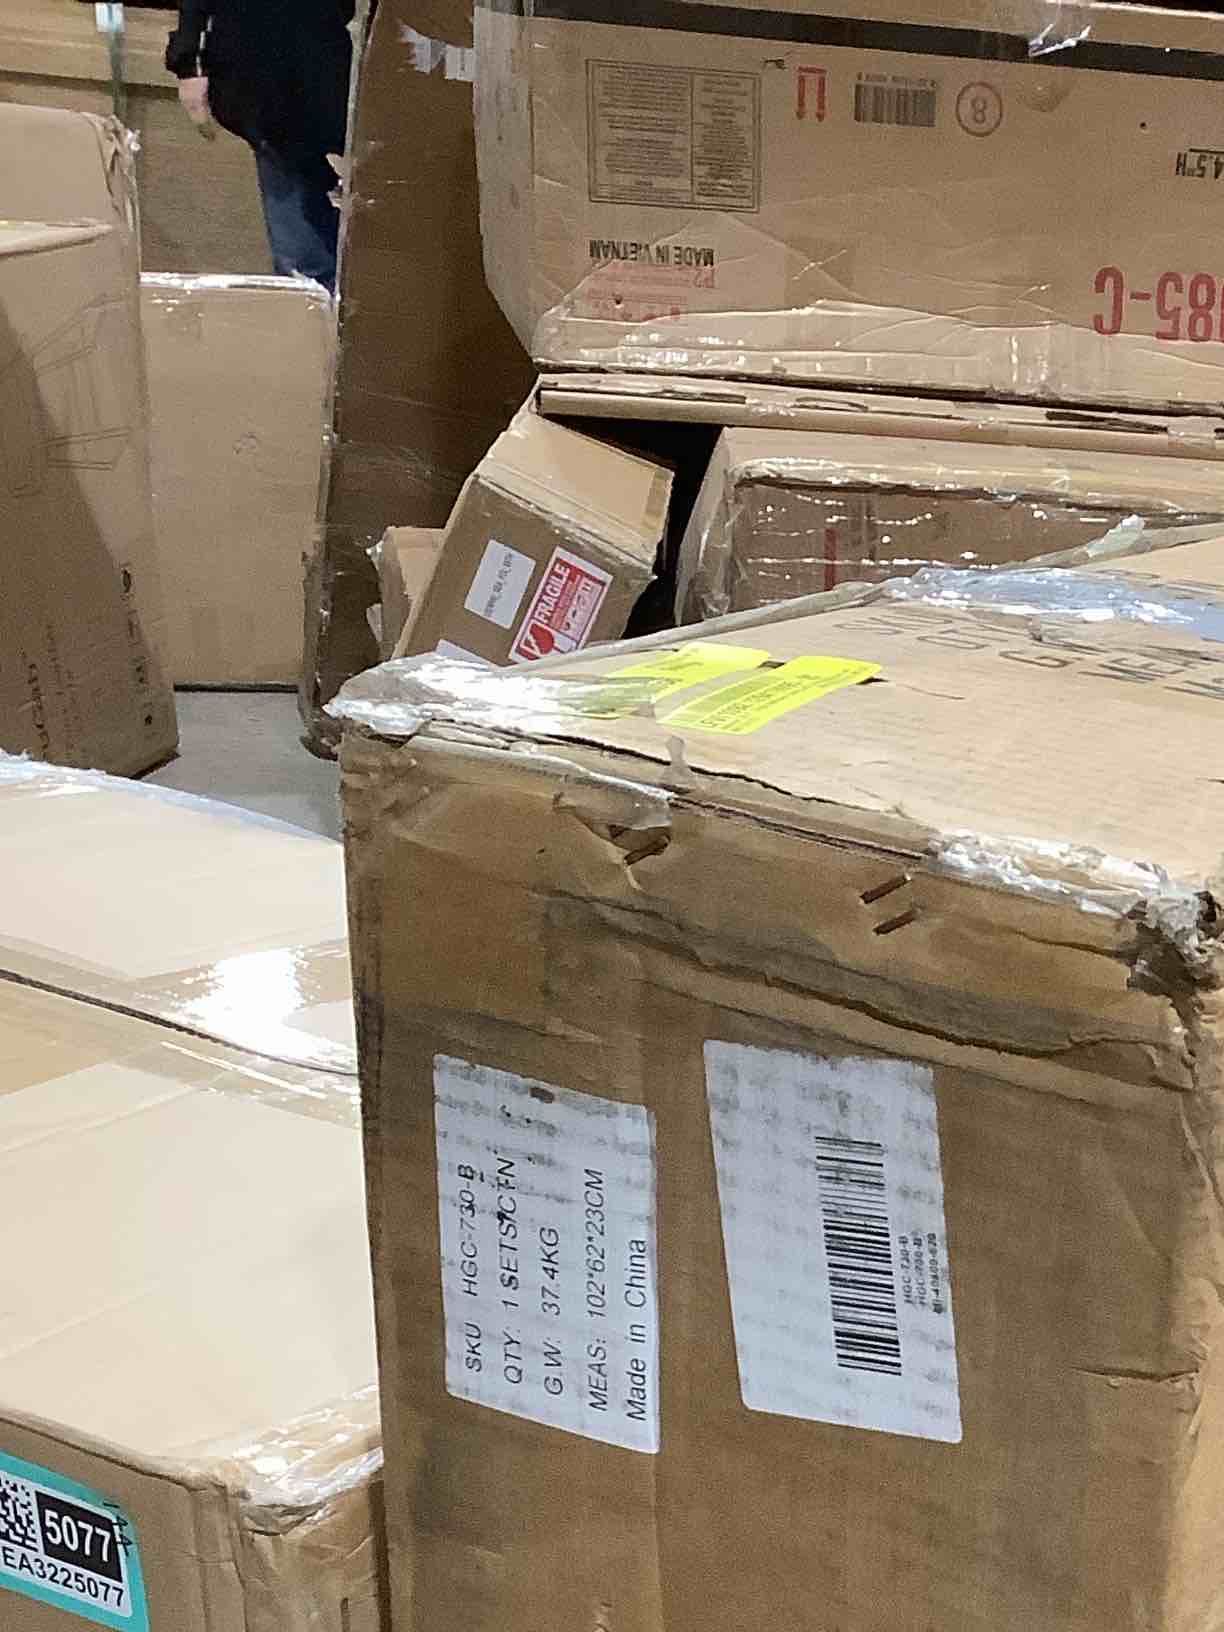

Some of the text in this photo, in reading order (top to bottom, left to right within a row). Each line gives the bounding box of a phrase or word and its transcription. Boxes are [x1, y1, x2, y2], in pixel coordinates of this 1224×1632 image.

[655, 244, 670, 265] IN
[673, 245, 715, 267] MADE
[534, 562, 571, 624] FRAGILE
[540, 1227, 562, 1316] 37.4KG
[464, 1321, 484, 1373] SKU
[623, 1238, 648, 1421] Made in China
[586, 1338, 609, 1412] MEAS:
[44, 1508, 111, 1562] 5077
